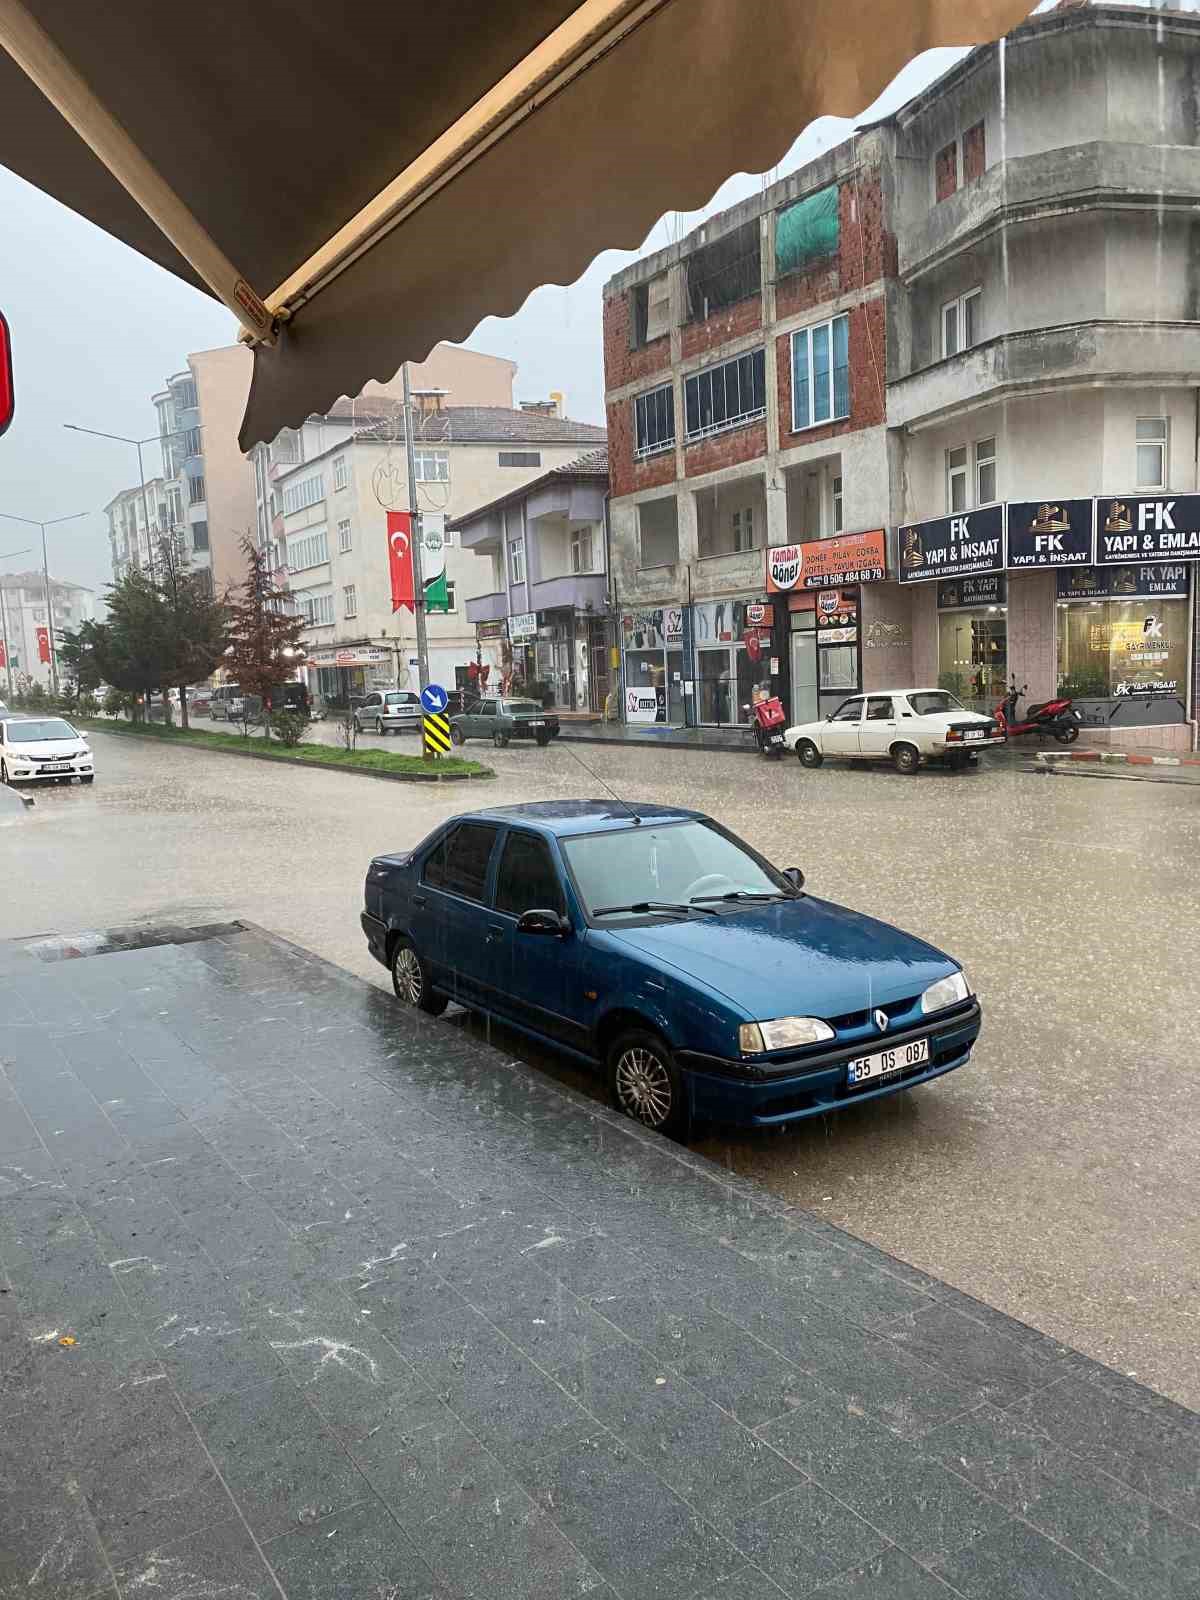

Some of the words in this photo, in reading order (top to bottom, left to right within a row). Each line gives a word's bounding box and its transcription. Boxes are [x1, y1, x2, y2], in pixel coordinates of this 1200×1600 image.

[1138, 501, 1177, 531] FK
[950, 516, 970, 541] FK
[1035, 534, 1064, 551] FK
[1104, 535, 1138, 552] YAPI
[1143, 534, 1154, 550] &
[1159, 531, 1200, 549] EMLA
[926, 548, 947, 565] YAPI
[950, 546, 958, 561] &
[961, 538, 1000, 562] İNŞAAT
[1013, 555, 1035, 564] YAPI
[1038, 554, 1047, 563] &
[1050, 552, 1087, 564] İNŞAAT
[772, 560, 800, 583] Döner
[833, 561, 854, 571] TAVUK
[1140, 567, 1155, 581] FK
[1160, 566, 1186, 580] YAPI
[823, 576, 829, 585] 0
[830, 574, 844, 584] 506
[845, 572, 859, 582] 484
[860, 570, 870, 581] 68
[871, 568, 882, 579] 79
[963, 581, 975, 593] FK
[978, 577, 998, 591] YAPI
[1149, 582, 1177, 592] EMLAK
[855, 1058, 871, 1079] 55
[881, 1051, 896, 1071] DS
[906, 1041, 926, 1063] 087
